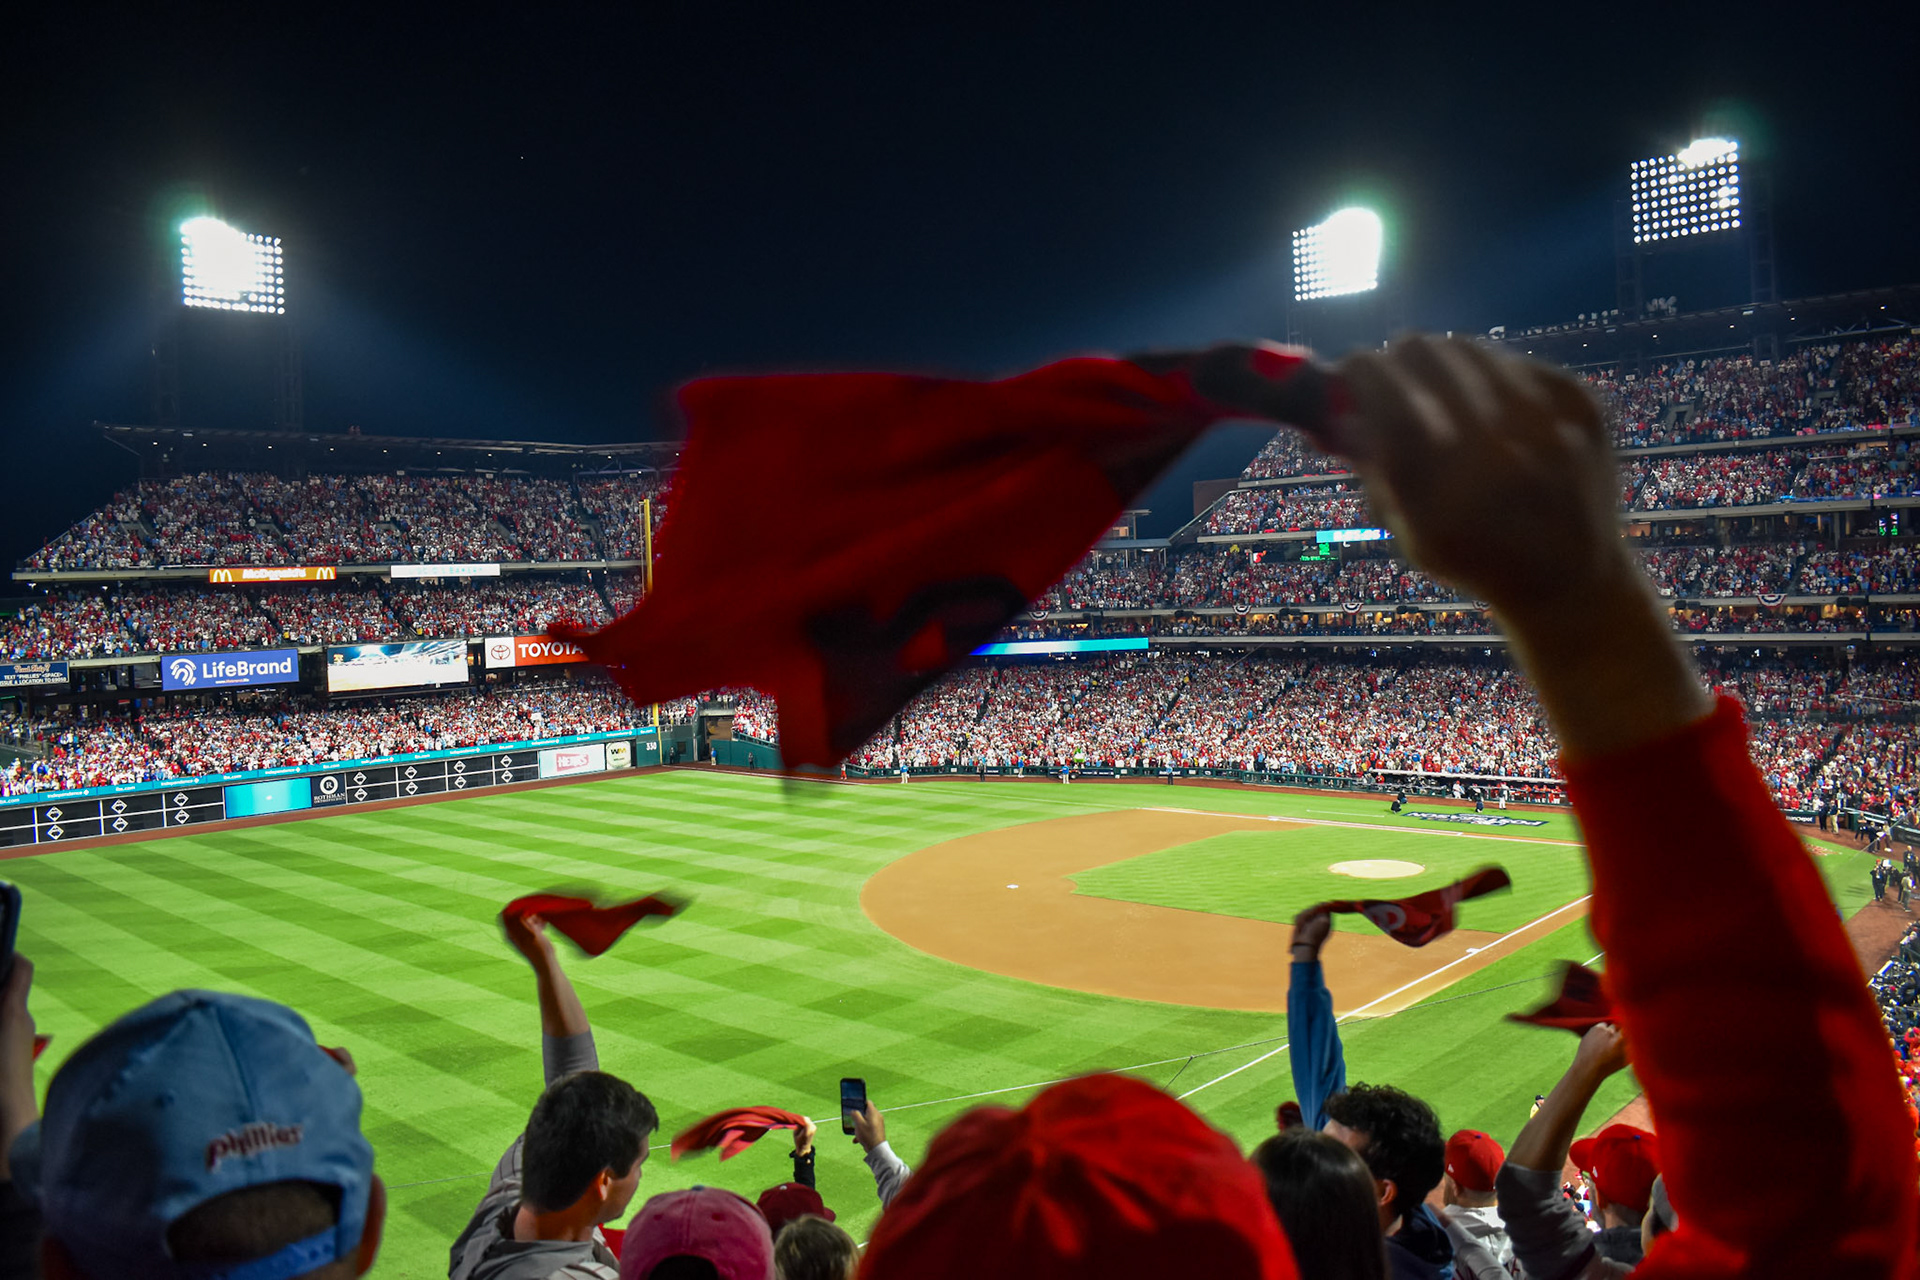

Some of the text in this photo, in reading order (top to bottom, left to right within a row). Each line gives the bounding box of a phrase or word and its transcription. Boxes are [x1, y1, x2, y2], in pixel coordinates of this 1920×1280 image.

[518, 642, 584, 658] TOYOTA
[203, 657, 292, 679] LifeBrand
[646, 742, 657, 751] 330
[314, 793, 346, 801] ROTHMAN
